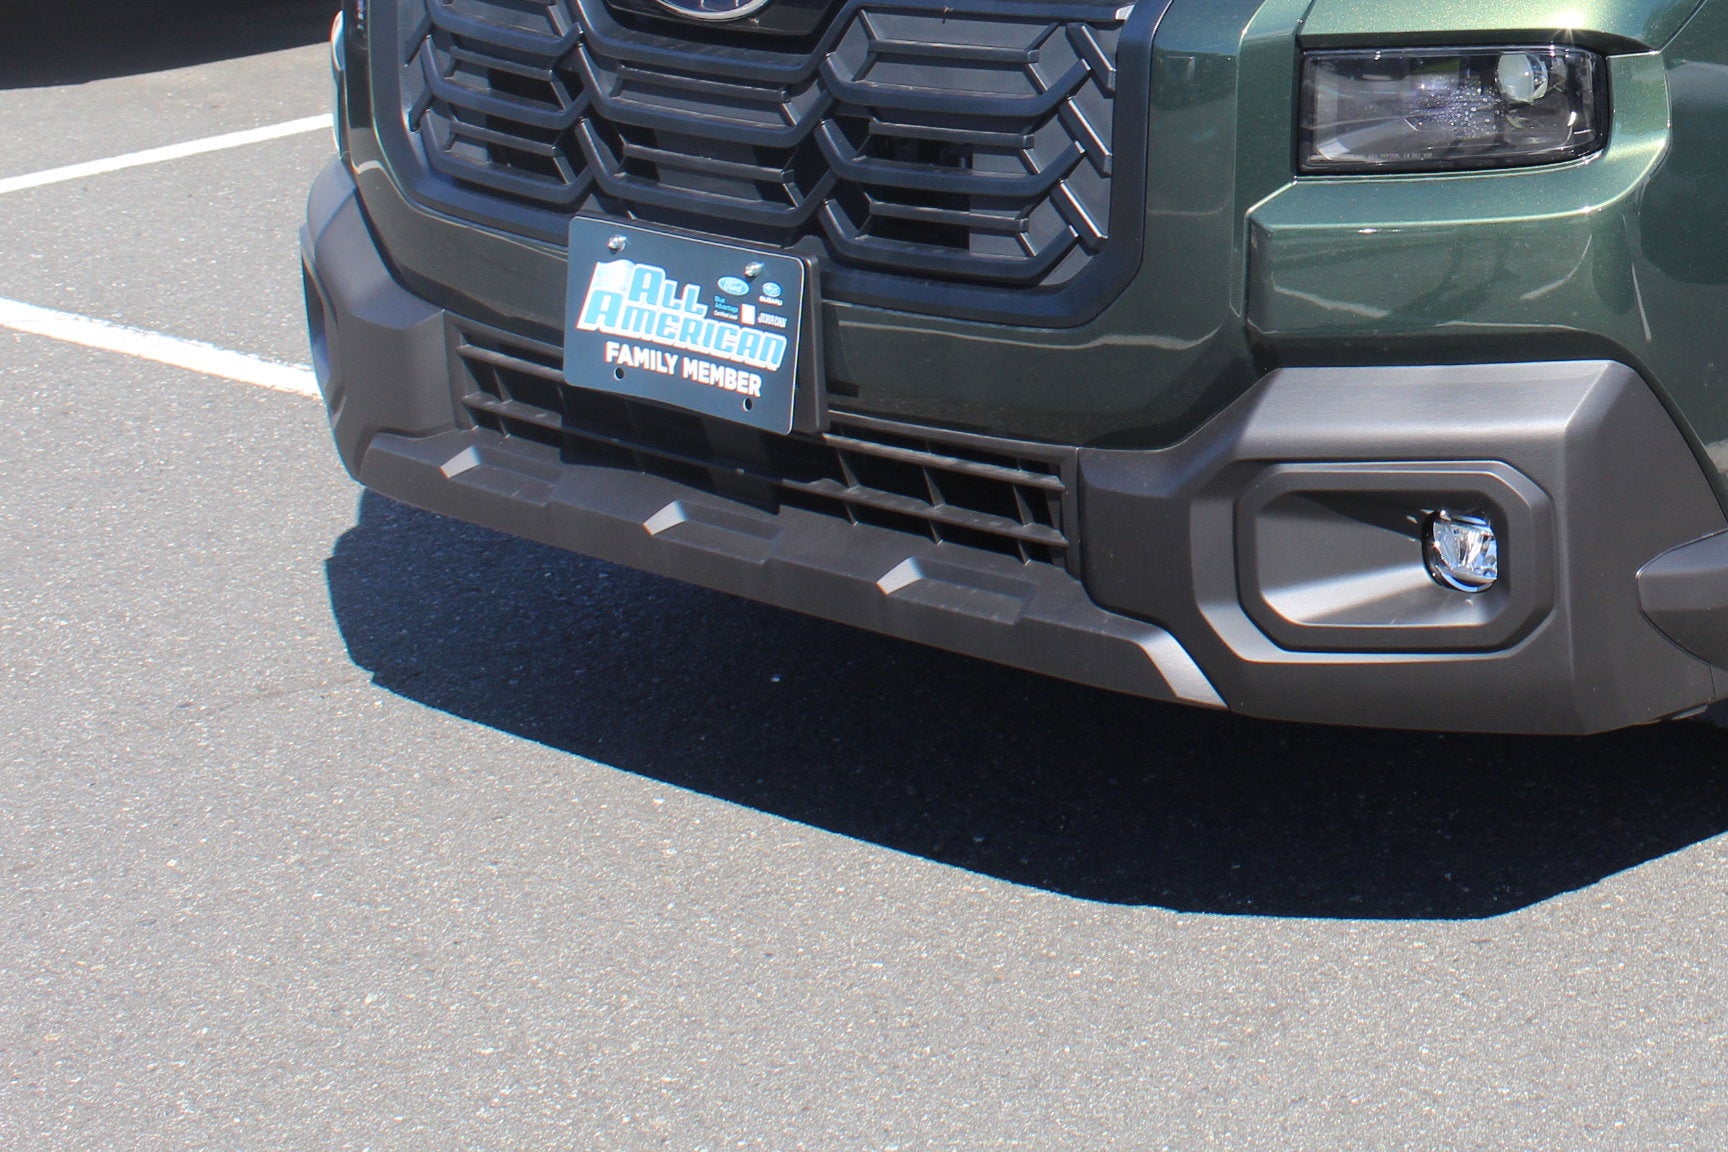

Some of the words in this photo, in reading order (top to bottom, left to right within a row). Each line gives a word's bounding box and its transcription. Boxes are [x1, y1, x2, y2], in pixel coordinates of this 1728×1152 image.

[629, 263, 707, 318] ALL
[758, 294, 783, 307] SUBARU
[577, 289, 787, 371] AMERICAN
[605, 341, 678, 376] FAMILY
[683, 356, 762, 397] MEMBER
